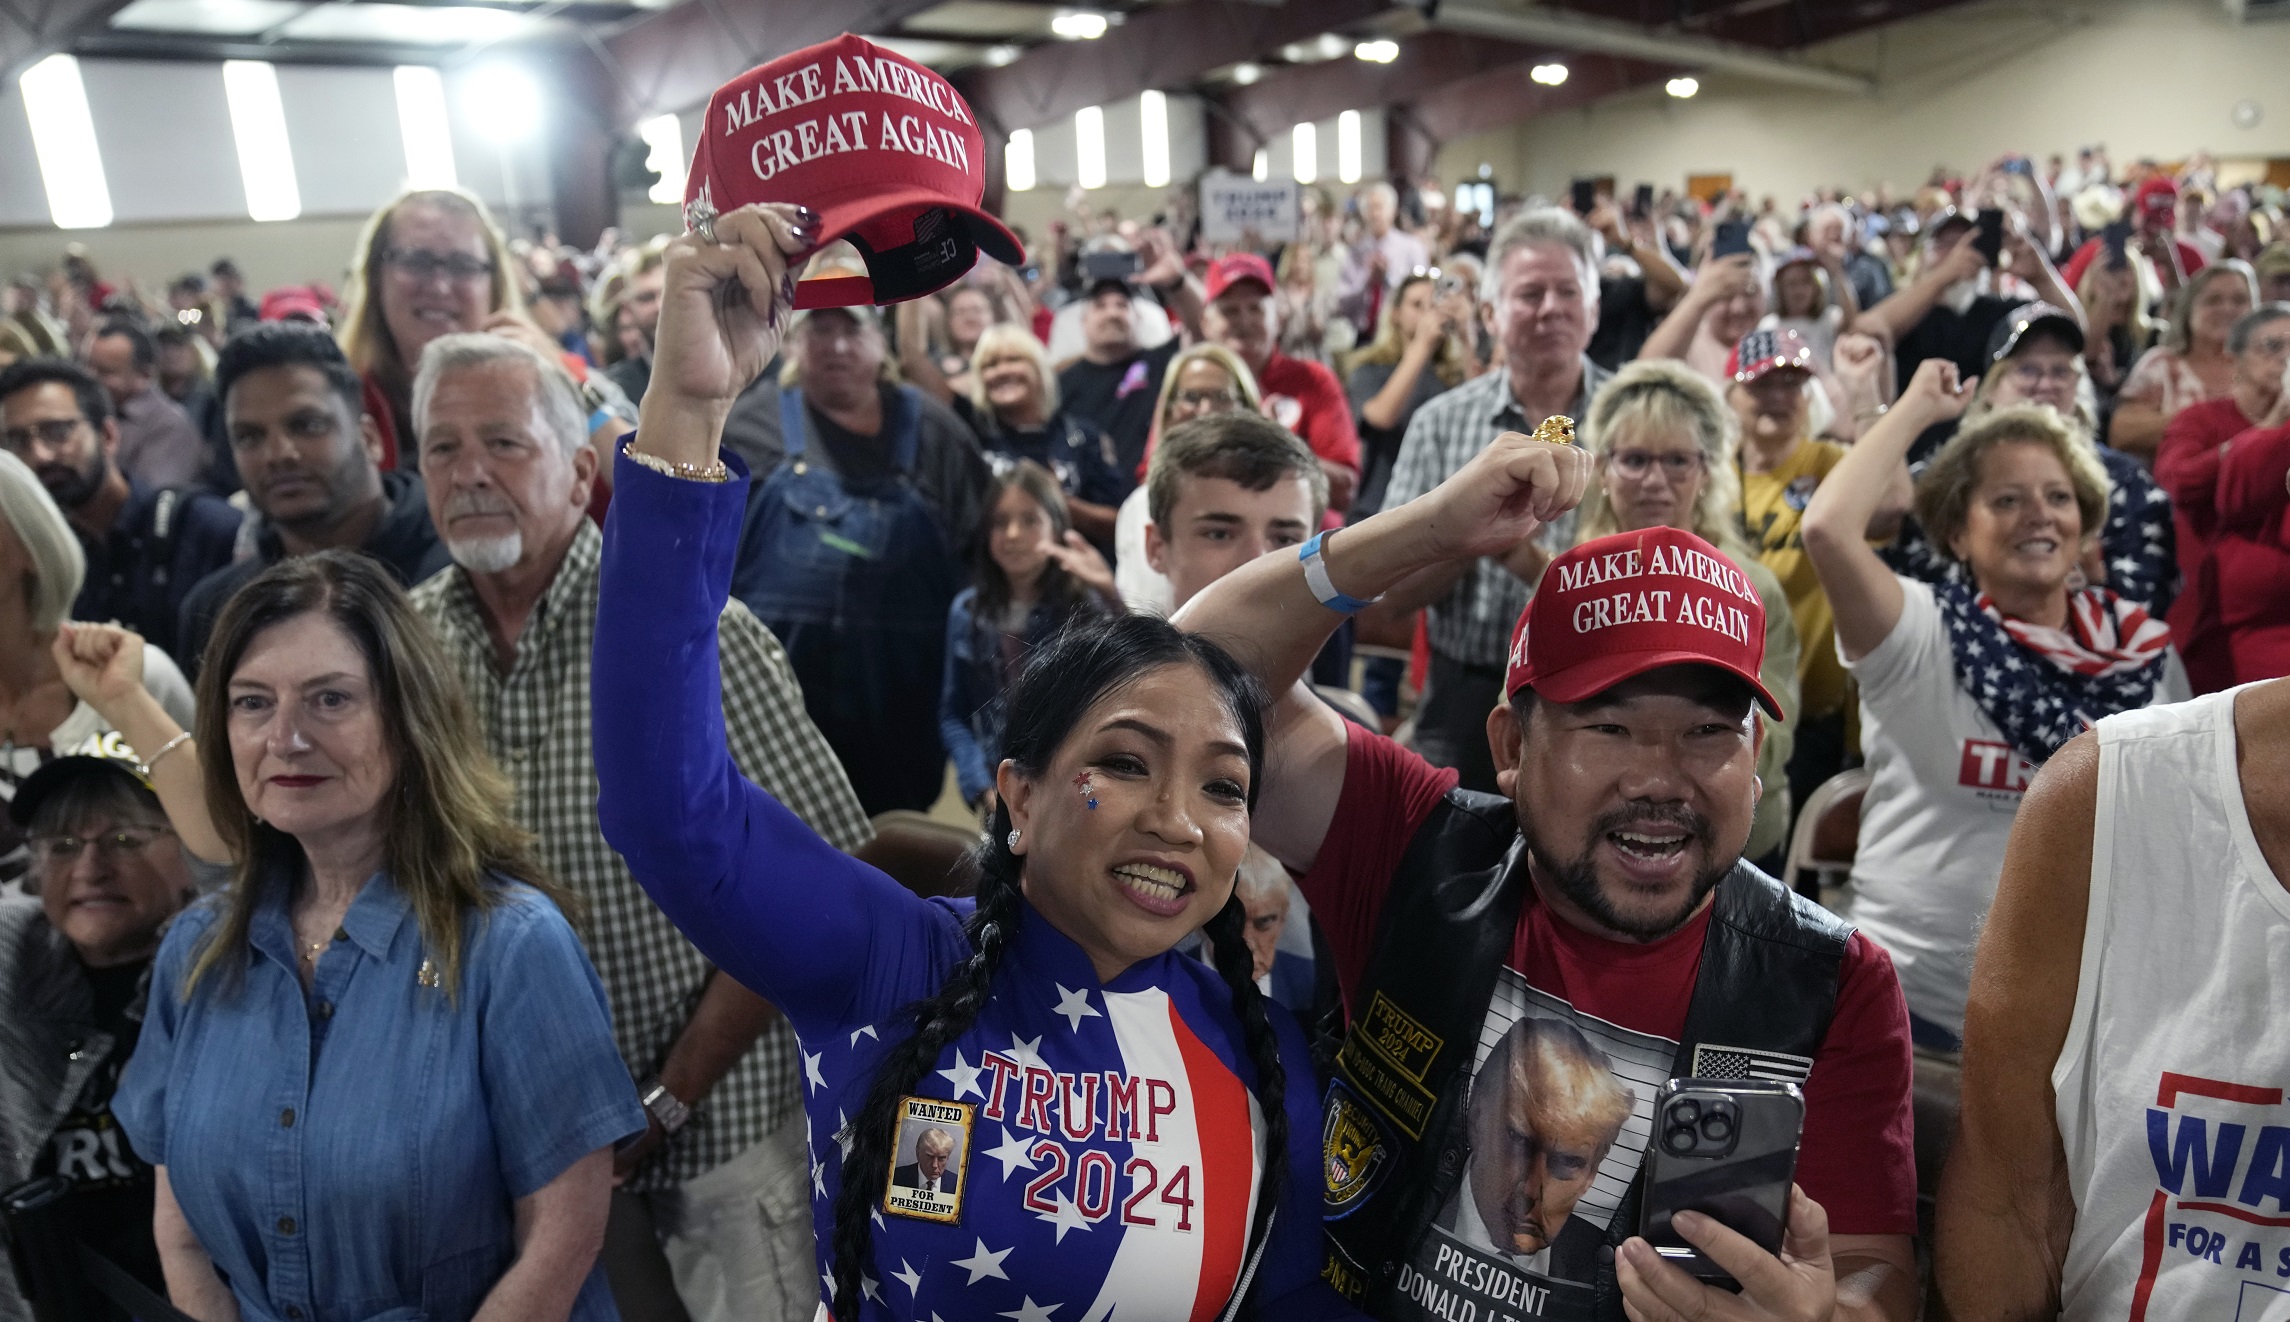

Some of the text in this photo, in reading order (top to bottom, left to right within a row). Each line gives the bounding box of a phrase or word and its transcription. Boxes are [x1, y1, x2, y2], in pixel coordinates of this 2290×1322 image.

[725, 56, 972, 137] MAKE AMERICA
[751, 111, 969, 181] GREAT AGAIN
[1557, 545, 1758, 607] MAKE AMERICA
[1572, 591, 1749, 646] GREAT AGAIN
[1376, 999, 1434, 1053] TRUMP
[1379, 1027, 1411, 1062] 2024
[909, 1102, 962, 1121] WANTED
[983, 1050, 1178, 1146] TRUMP
[890, 1197, 953, 1214] PRESIDENT
[912, 1189, 934, 1201] FOR
[1023, 1139, 1195, 1232] 2024
[2168, 1223, 2226, 1265] FOR
[2235, 1241, 2262, 1272] A
[1397, 1262, 1477, 1322] DONALD
[1434, 1243, 1550, 1317] PRESIDENT
